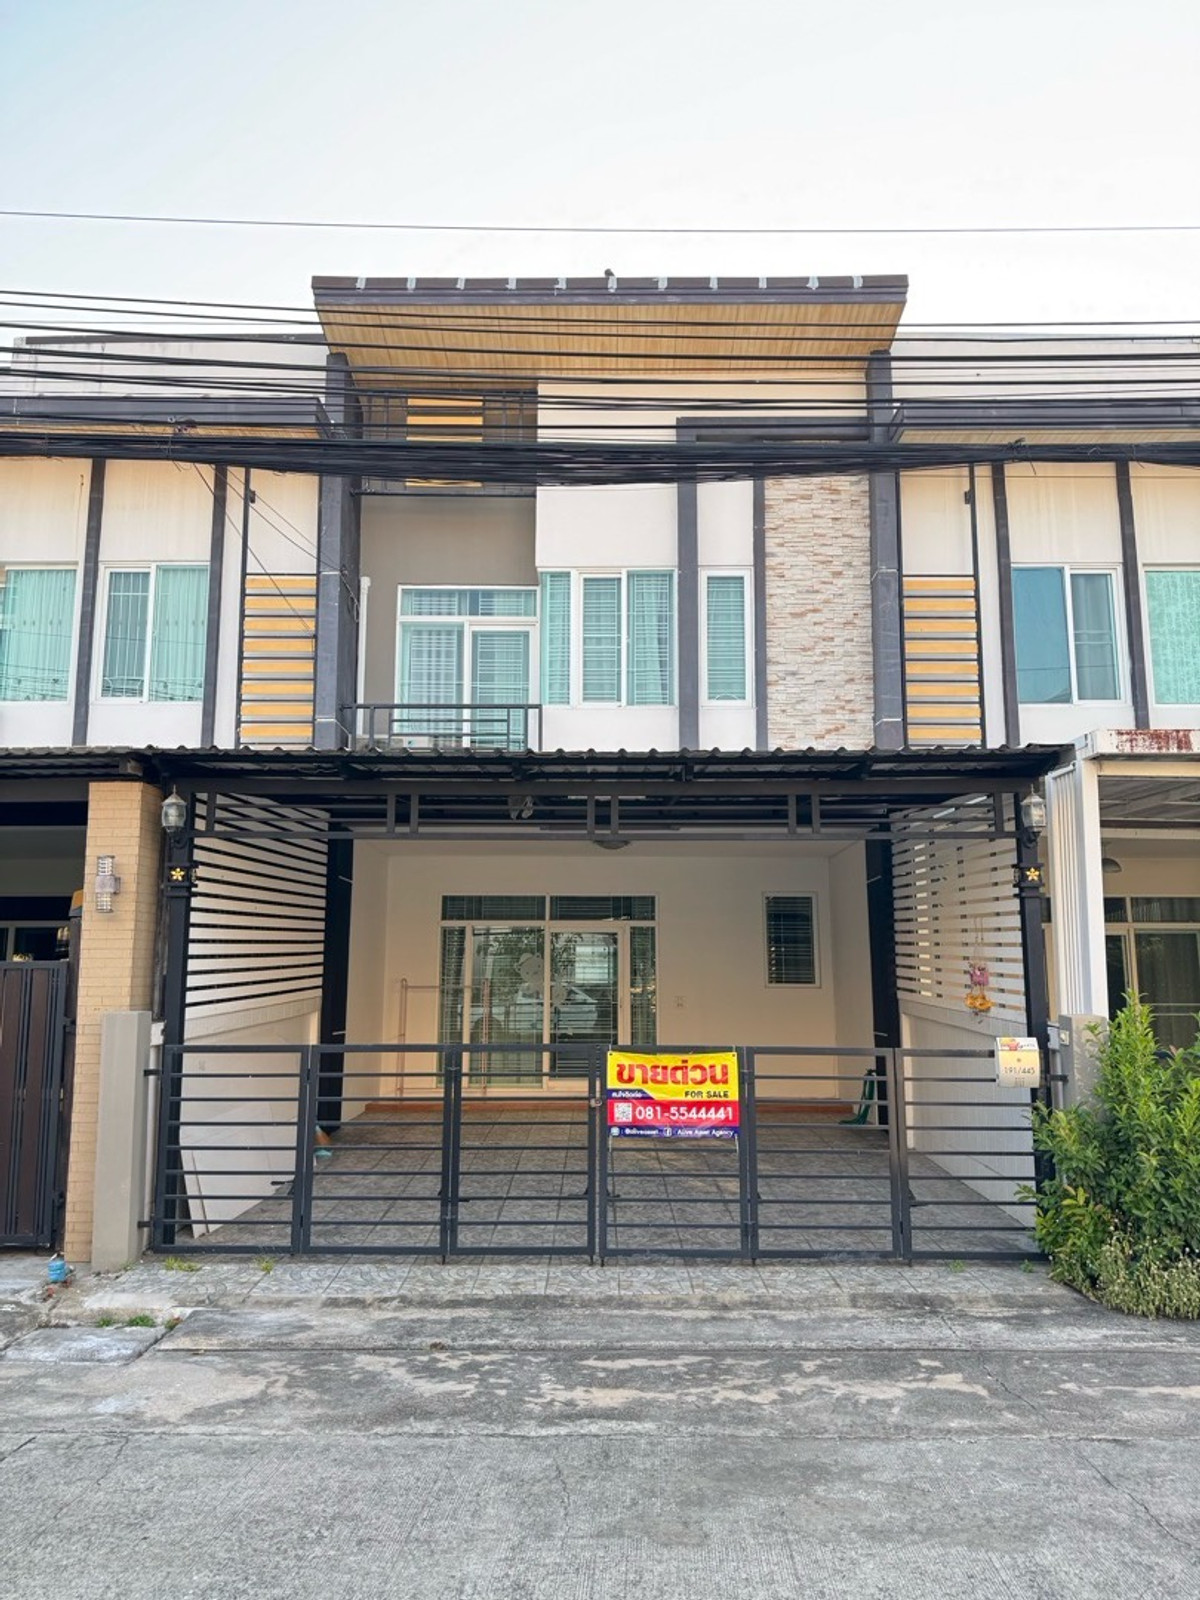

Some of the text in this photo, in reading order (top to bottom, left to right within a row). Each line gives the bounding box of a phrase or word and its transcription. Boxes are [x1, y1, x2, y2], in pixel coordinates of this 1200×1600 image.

[617, 1060, 728, 1085] ขายด่วน
[635, 1106, 733, 1120] 081-5544441
